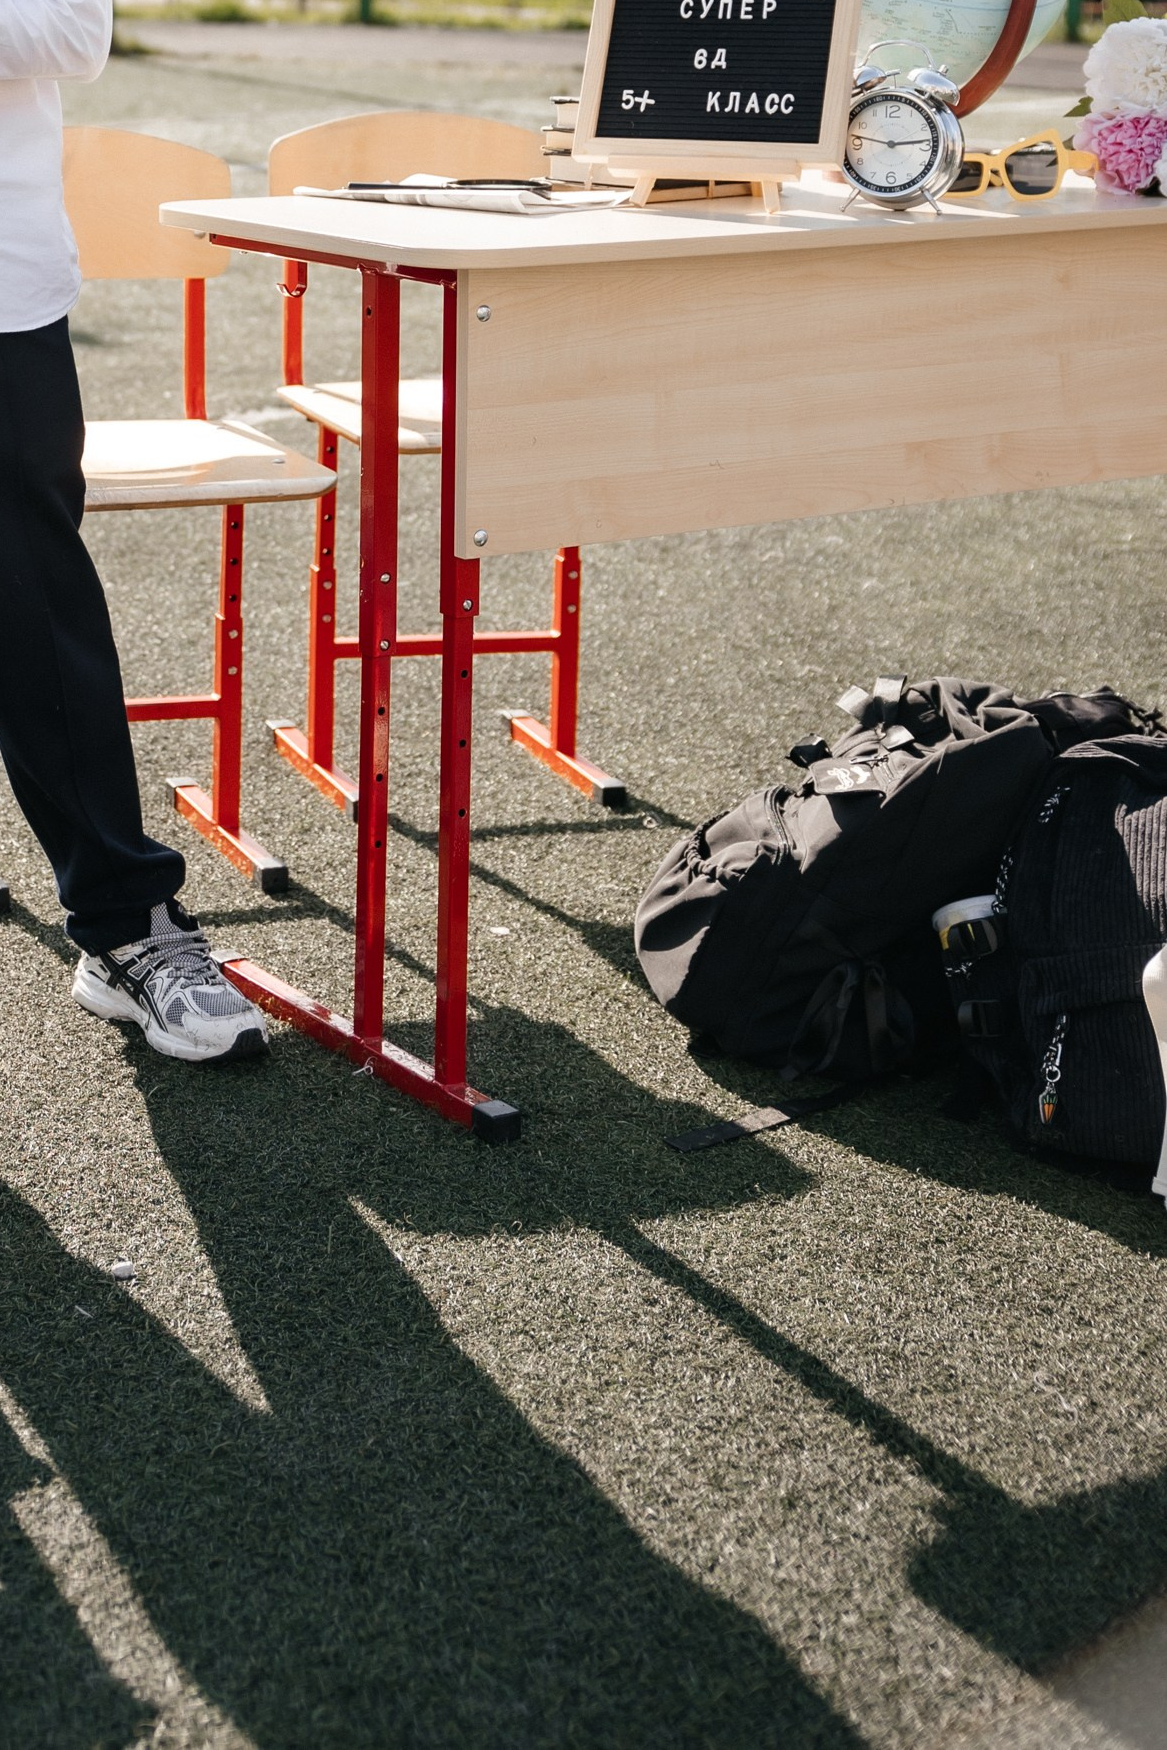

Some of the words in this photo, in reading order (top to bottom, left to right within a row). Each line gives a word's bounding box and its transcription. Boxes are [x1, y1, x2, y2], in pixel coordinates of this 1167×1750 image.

[693, 48, 727, 69] 6Д
[621, 89, 656, 113] 5+
[706, 91, 795, 115] КЛАСС
[885, 105, 901, 119] 12
[858, 121, 868, 130] 10
[920, 123, 929, 131] 2
[852, 136, 863, 150] 9
[919, 139, 932, 151] 3
[870, 171, 877, 179] 7
[886, 172, 897, 185] 6
